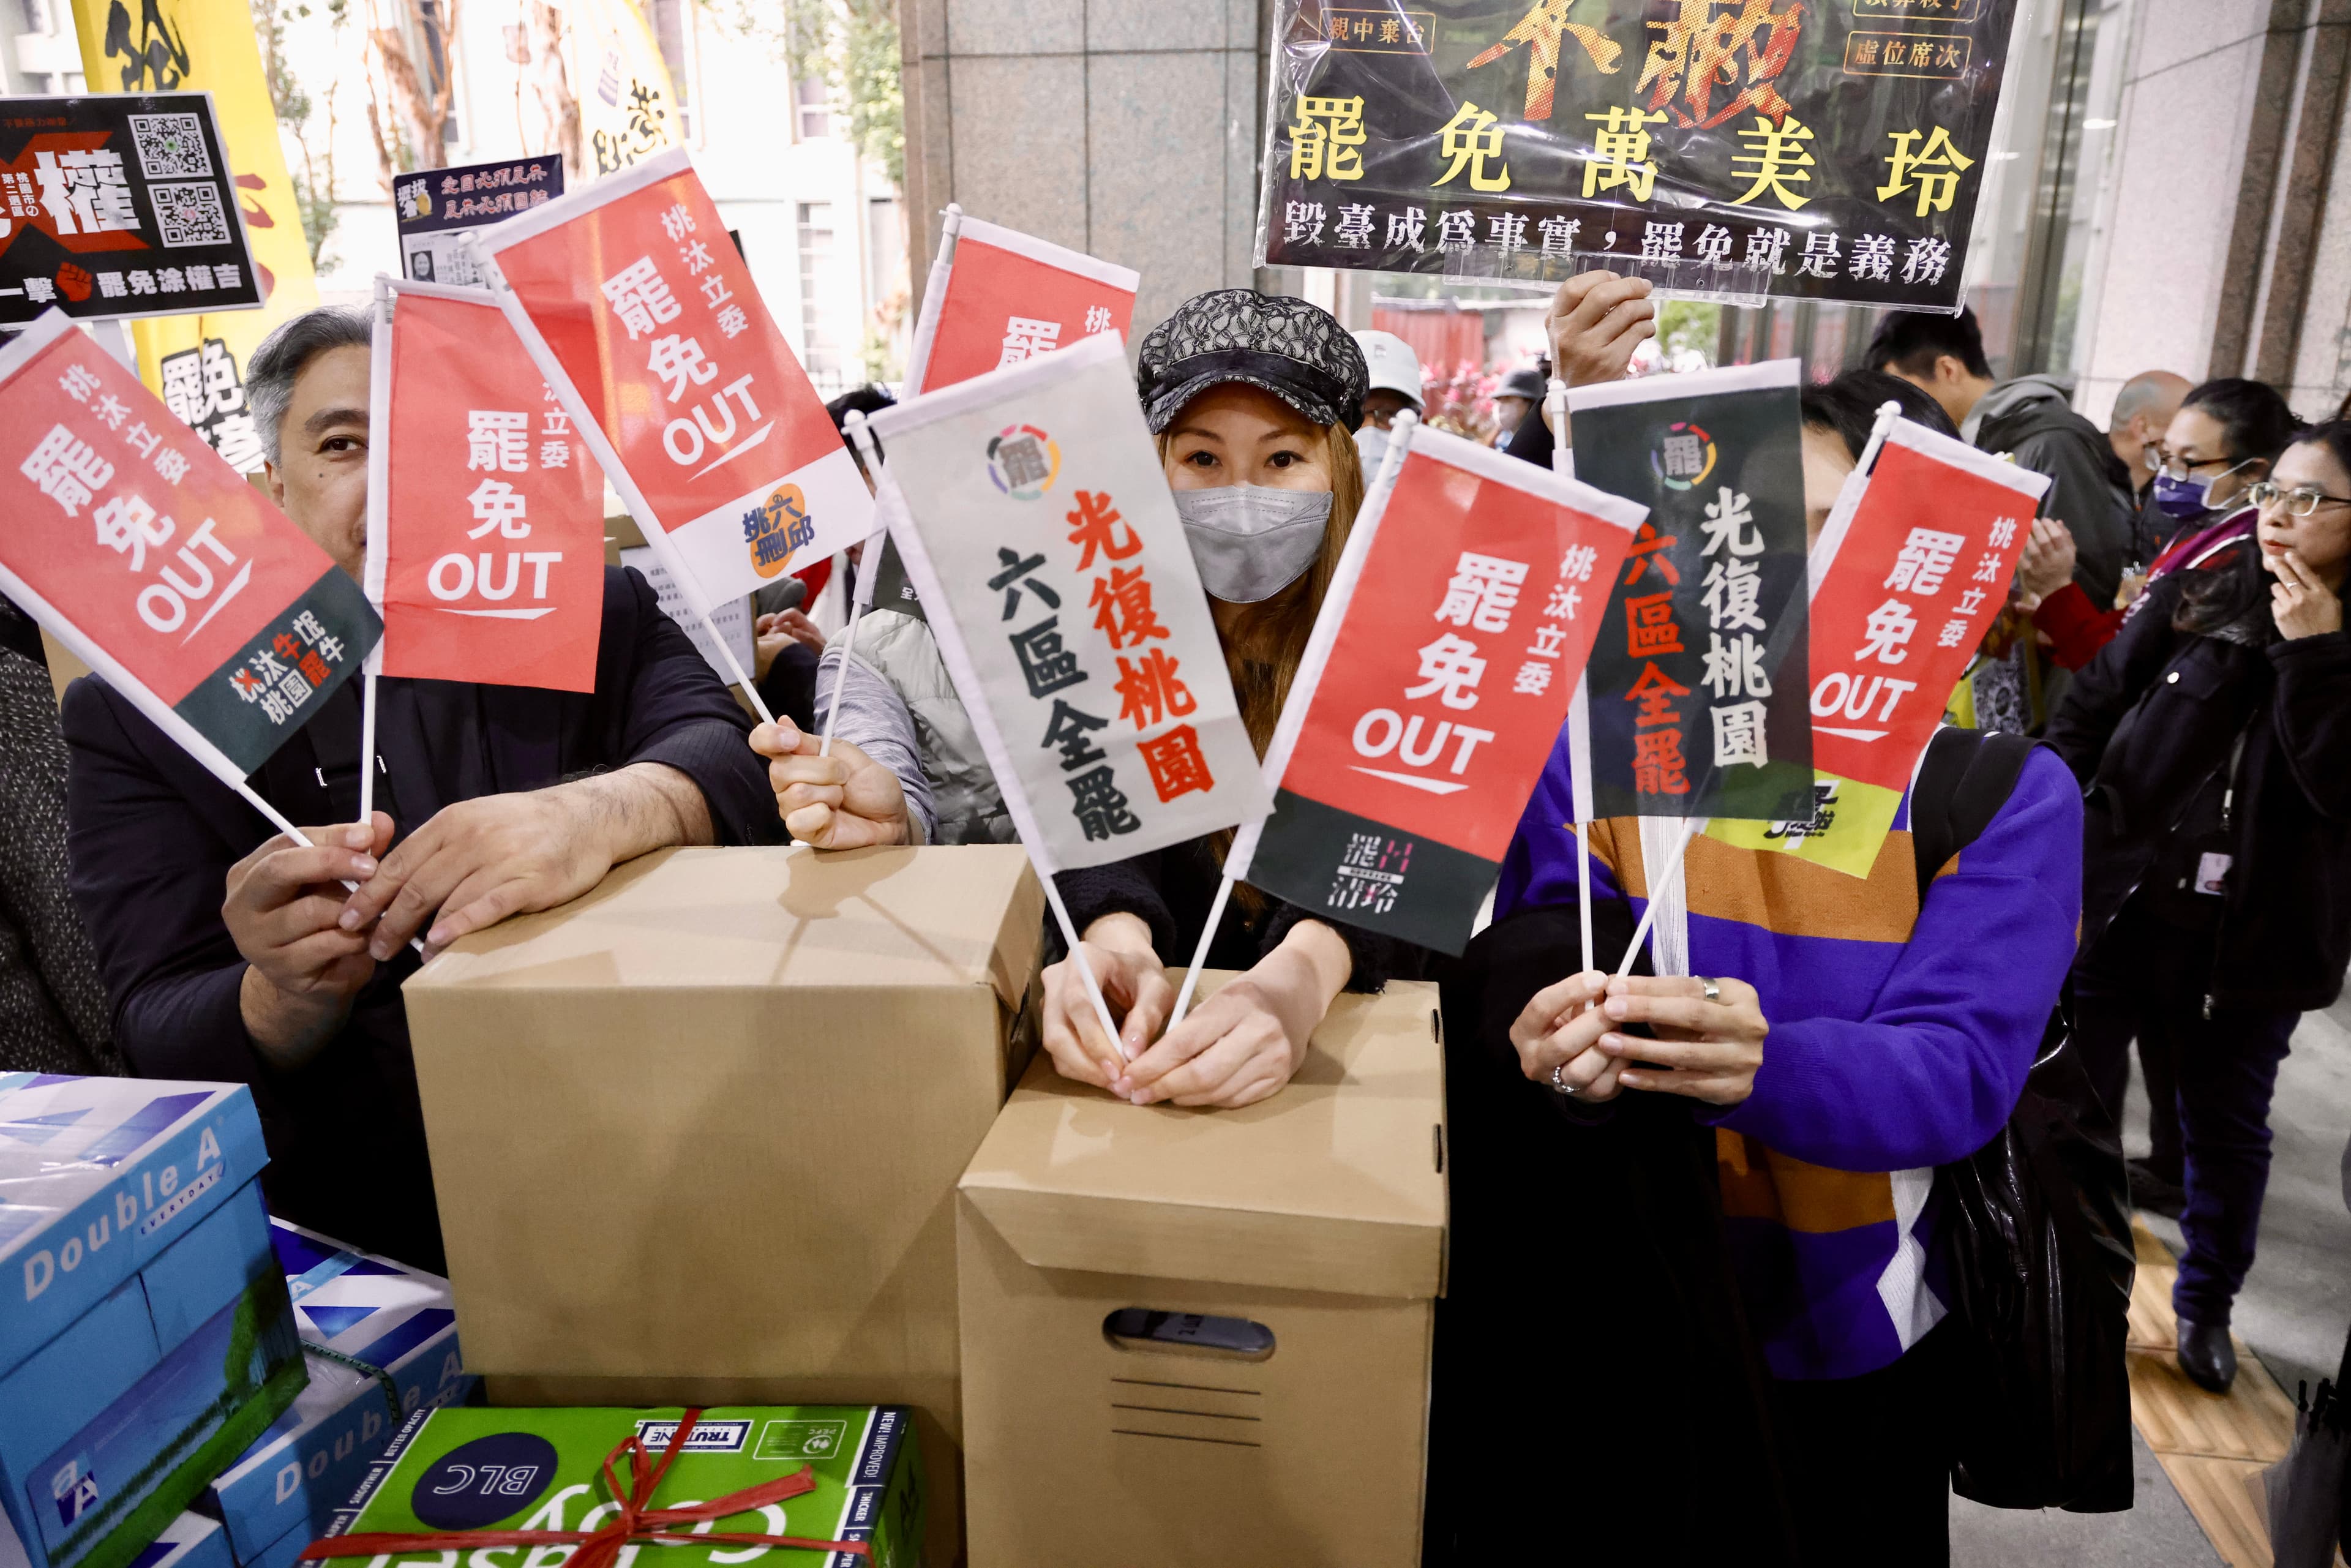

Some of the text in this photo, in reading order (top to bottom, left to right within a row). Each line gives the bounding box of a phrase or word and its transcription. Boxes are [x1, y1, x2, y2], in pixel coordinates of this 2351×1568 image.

[1330, 17, 1425, 44] 親中棄台
[1854, 39, 1961, 69] 虛位席次
[34, 149, 141, 235] 權
[1288, 95, 1975, 218] 罷免萬美玲
[96, 263, 242, 299] 罷免涂權吉
[661, 203, 749, 339] 桃汰立委
[1085, 305, 1112, 332] 桃
[600, 255, 718, 403] 罷免
[58, 363, 191, 486] 桃汰立委
[662, 374, 763, 465] OUT
[999, 433, 1049, 489] 罷
[1663, 435, 1703, 476] 罷
[20, 424, 176, 572] 罷免
[467, 410, 531, 540] 罷免
[137, 517, 238, 634] OUT
[427, 552, 563, 601] OUT
[1512, 543, 1598, 697] 桃汰立委
[1854, 527, 1967, 666] 罷免
[1937, 516, 2018, 648] 桃汰立委
[1066, 489, 1215, 803] 光復桃園
[1404, 551, 1530, 712] 罷免
[1624, 522, 1691, 796] 六區全罷
[1700, 486, 1772, 770] 光復桃園
[988, 547, 1142, 842] 六區全罷
[1352, 708, 1495, 775] OUT
[1811, 672, 1917, 723] OUT
[24, 1126, 222, 1302] Double A
[141, 1174, 214, 1235] EVERYDAY
[276, 1386, 421, 1505] Doube
[384, 1408, 426, 1457] BETTER OPACITY
[433, 1465, 539, 1496] BLC
[650, 1431, 730, 1442] TRUTNE
[863, 1412, 896, 1478] NEW! IMPROVED!
[854, 1492, 874, 1522] THICKER
